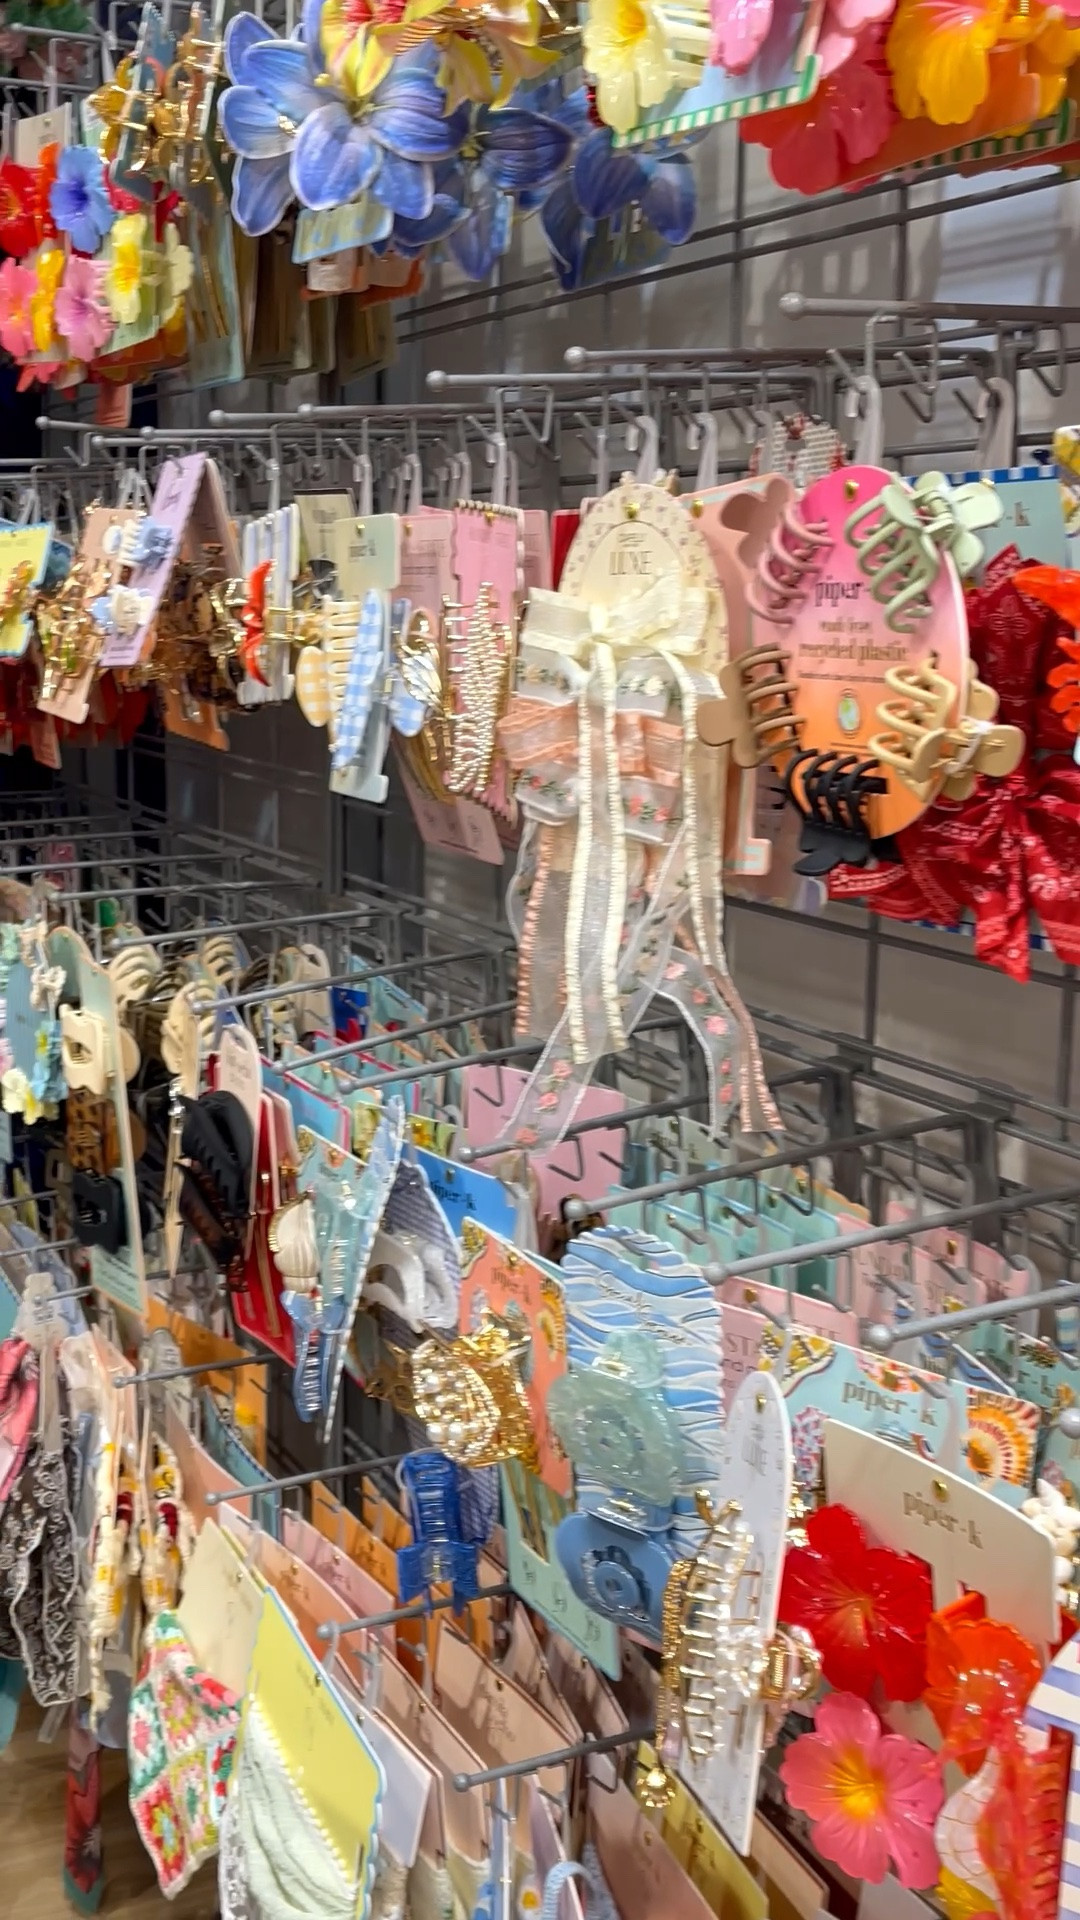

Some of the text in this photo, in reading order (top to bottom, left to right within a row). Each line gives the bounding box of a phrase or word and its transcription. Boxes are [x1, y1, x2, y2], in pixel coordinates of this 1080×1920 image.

[815, 575, 872, 608] piper-
[857, 638, 908, 667] plastic
[902, 1491, 984, 1550] piper-k
